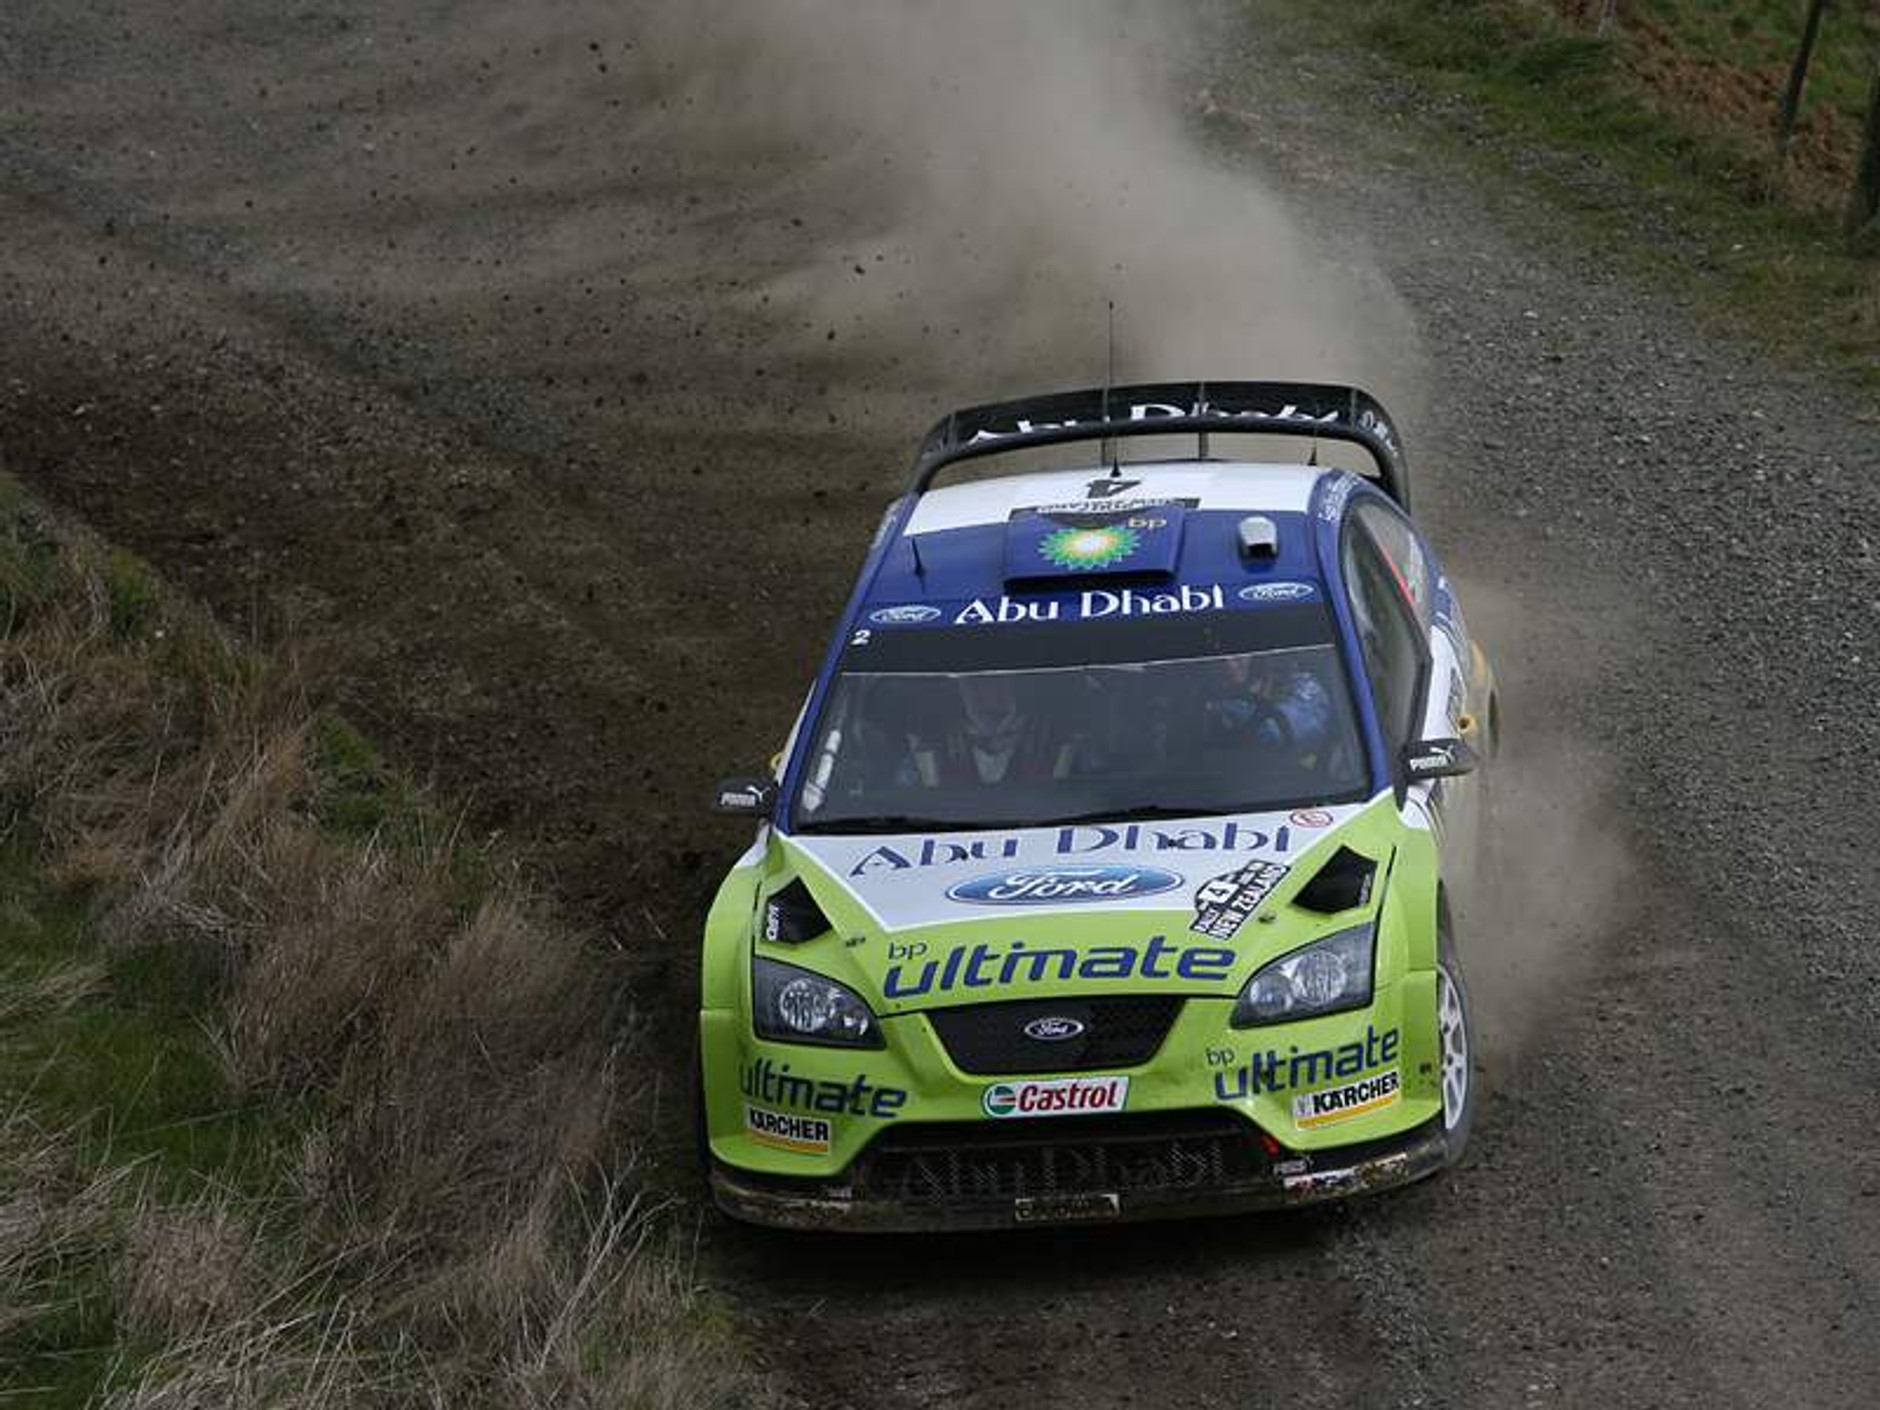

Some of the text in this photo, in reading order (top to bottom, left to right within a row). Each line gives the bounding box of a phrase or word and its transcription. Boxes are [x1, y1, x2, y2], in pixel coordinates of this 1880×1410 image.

[1128, 517, 1167, 530] bp
[953, 585, 1224, 625] Abu Dhabi
[851, 629, 871, 646] 2
[849, 822, 1289, 877] Abu Dhabi
[989, 869, 1140, 900] Ford
[883, 935, 1236, 999] ultimate
[888, 942, 928, 961] bp
[1206, 1047, 1235, 1066] bp
[1215, 1025, 1398, 1101] ultimate
[740, 1057, 908, 1118] ultimate
[1019, 1081, 1118, 1112] Castrol
